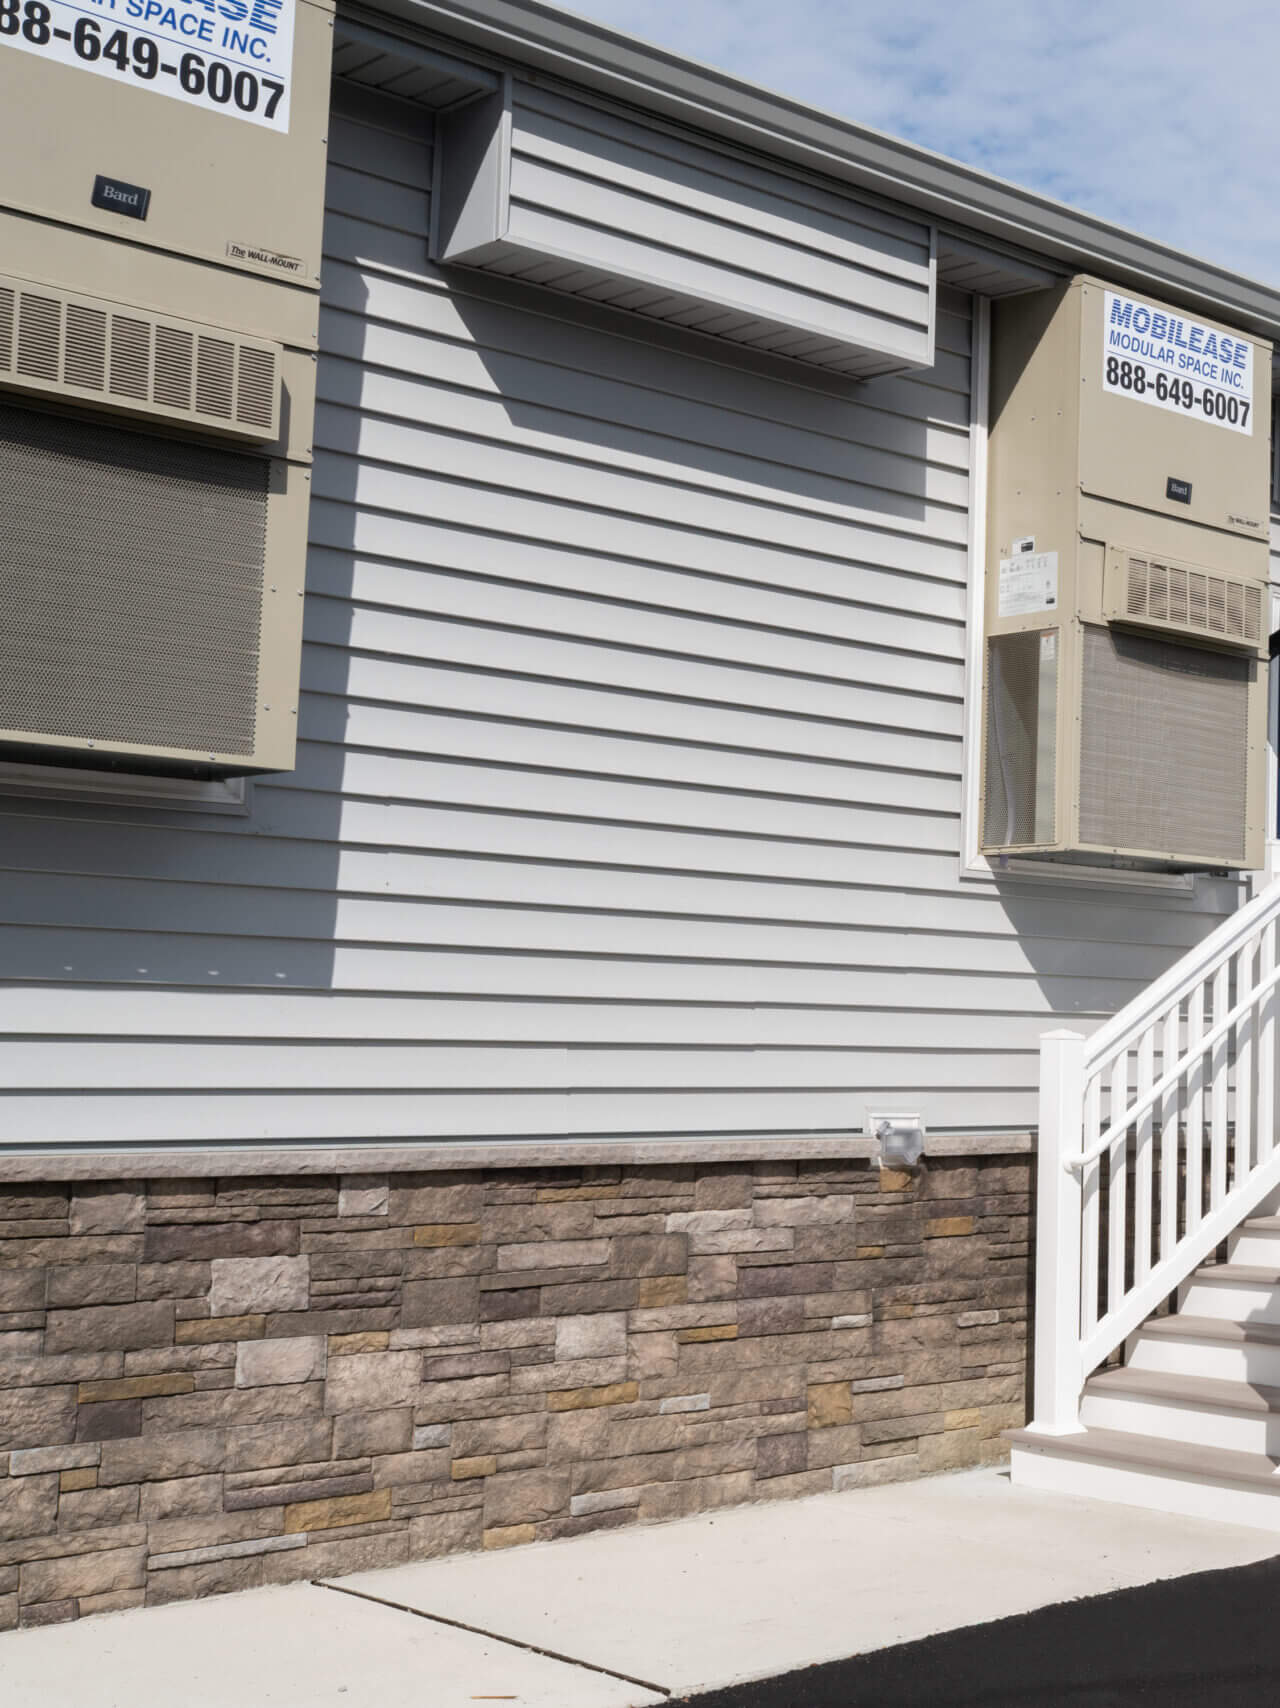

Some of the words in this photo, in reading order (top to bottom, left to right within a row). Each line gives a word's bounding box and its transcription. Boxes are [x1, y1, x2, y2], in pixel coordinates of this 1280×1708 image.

[126, 0, 216, 42] SPACE
[221, 27, 271, 63] INC.
[103, 185, 138, 206] Bard
[231, 245, 246, 258] The
[247, 250, 299, 271] WALL-MOUNT
[1109, 329, 1175, 365] MODULAR
[1178, 353, 1218, 380] SPACE
[1220, 367, 1244, 389] INC.
[1110, 298, 1248, 370] MOBILEASE
[1106, 356, 1250, 427] 888-649-6007
